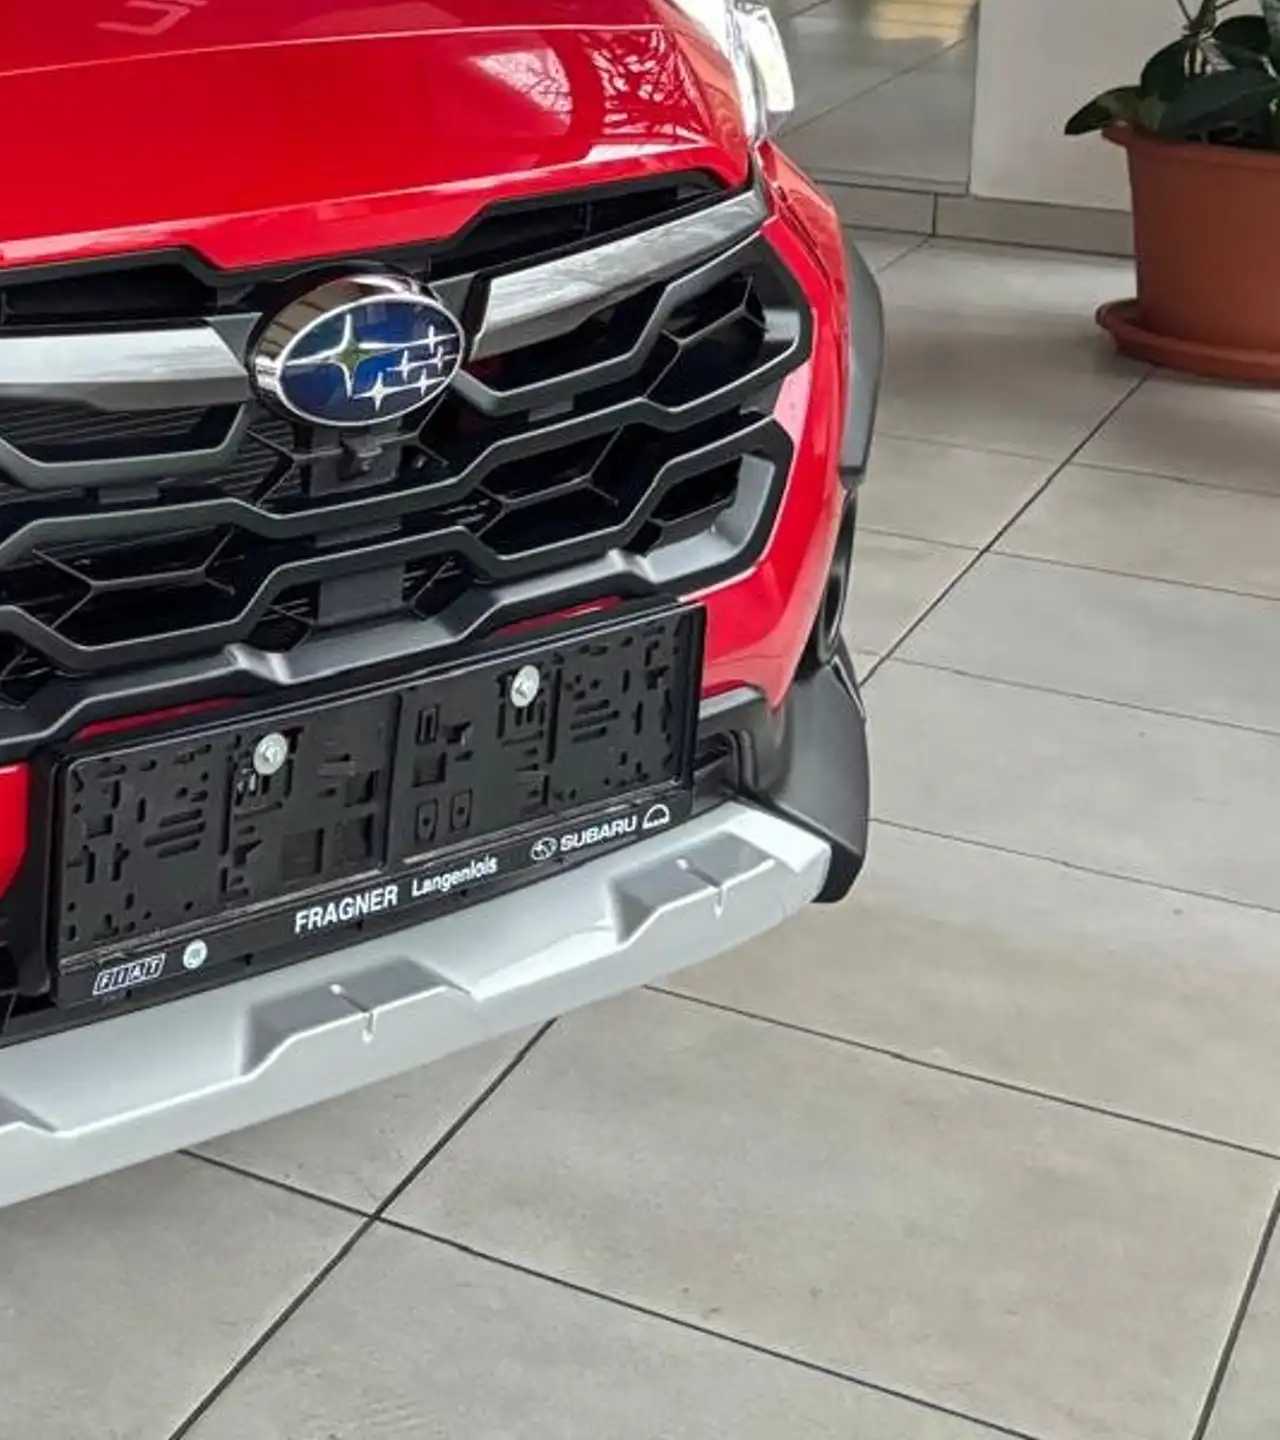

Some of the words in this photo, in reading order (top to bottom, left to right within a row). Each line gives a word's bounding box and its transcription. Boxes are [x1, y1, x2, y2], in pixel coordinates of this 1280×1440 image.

[559, 815, 639, 852] SUBARU
[294, 884, 398, 934] FRAGNER
[411, 856, 499, 897] Langenlois
[94, 955, 164, 995] FIAT
